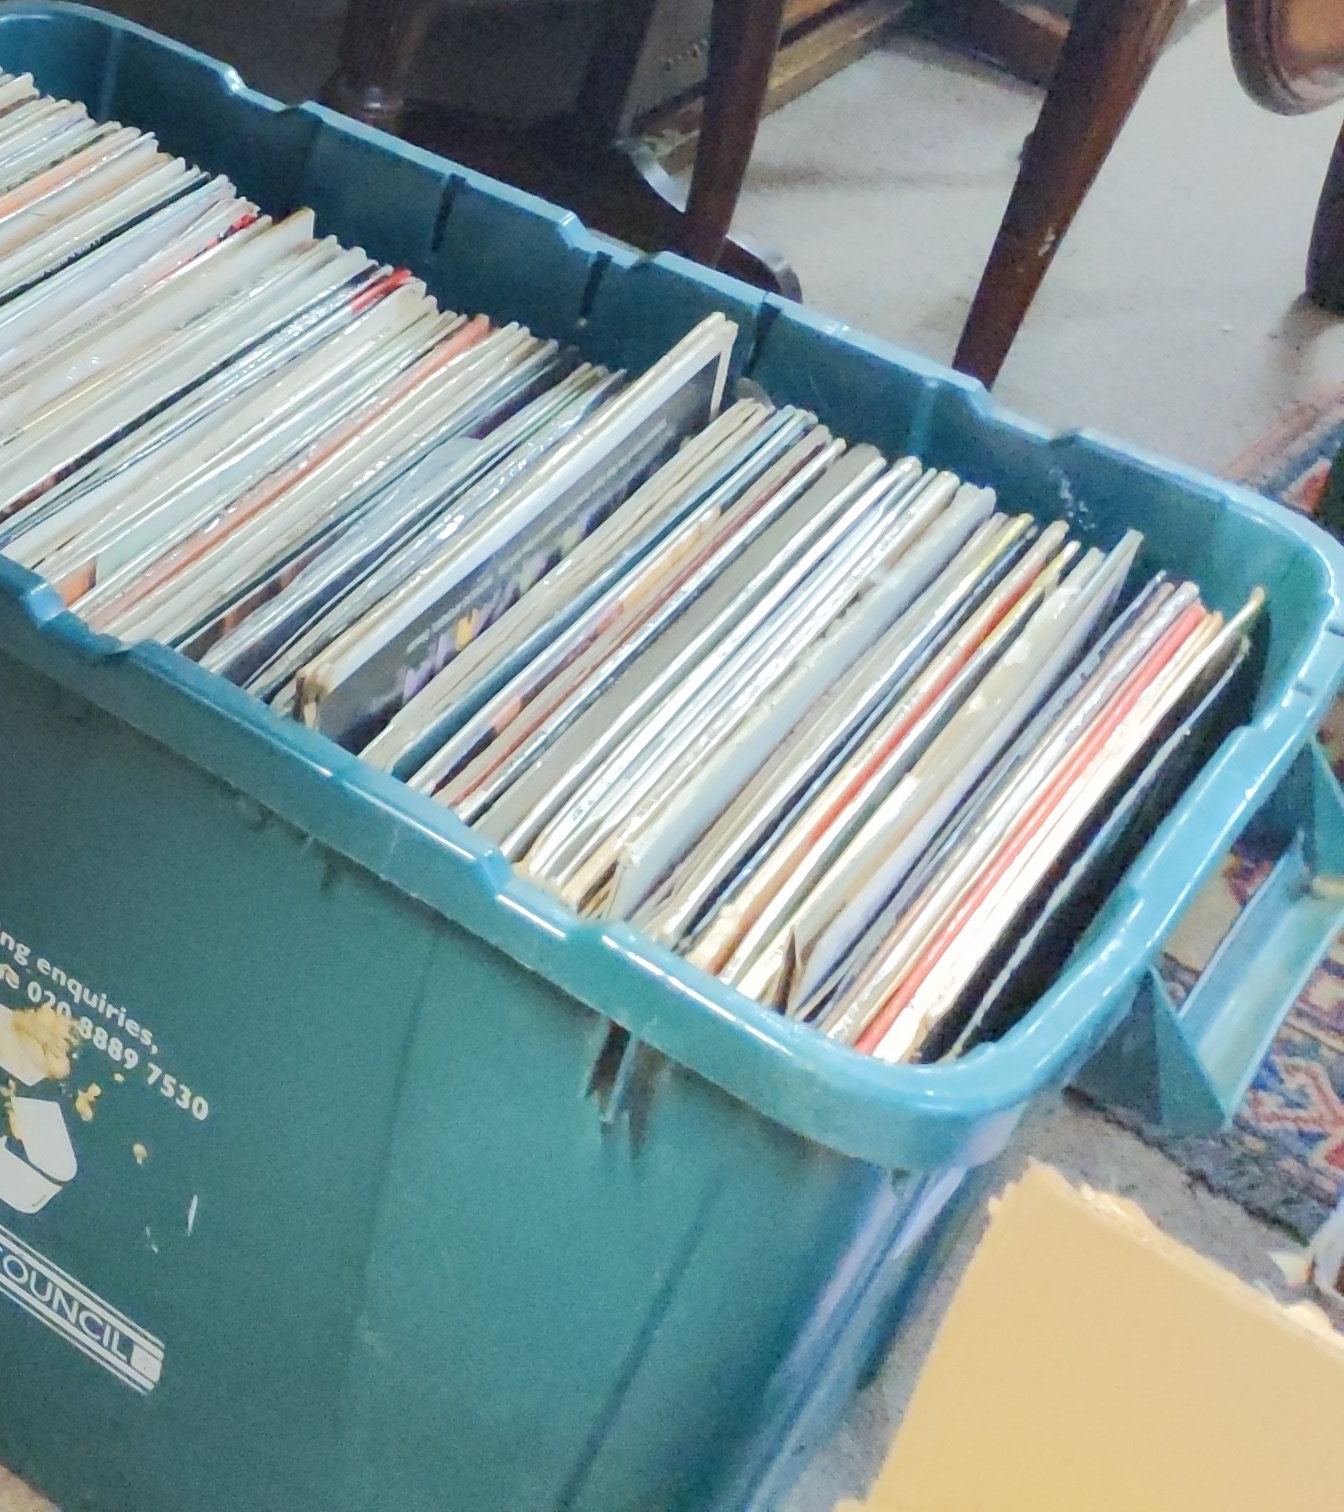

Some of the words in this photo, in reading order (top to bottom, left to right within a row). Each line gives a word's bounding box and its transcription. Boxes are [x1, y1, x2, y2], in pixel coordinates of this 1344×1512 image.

[27, 981, 73, 1019] 020
[77, 1016, 139, 1069] 8889
[147, 1062, 209, 1120] 7530
[36, 958, 158, 1055] enquiries,
